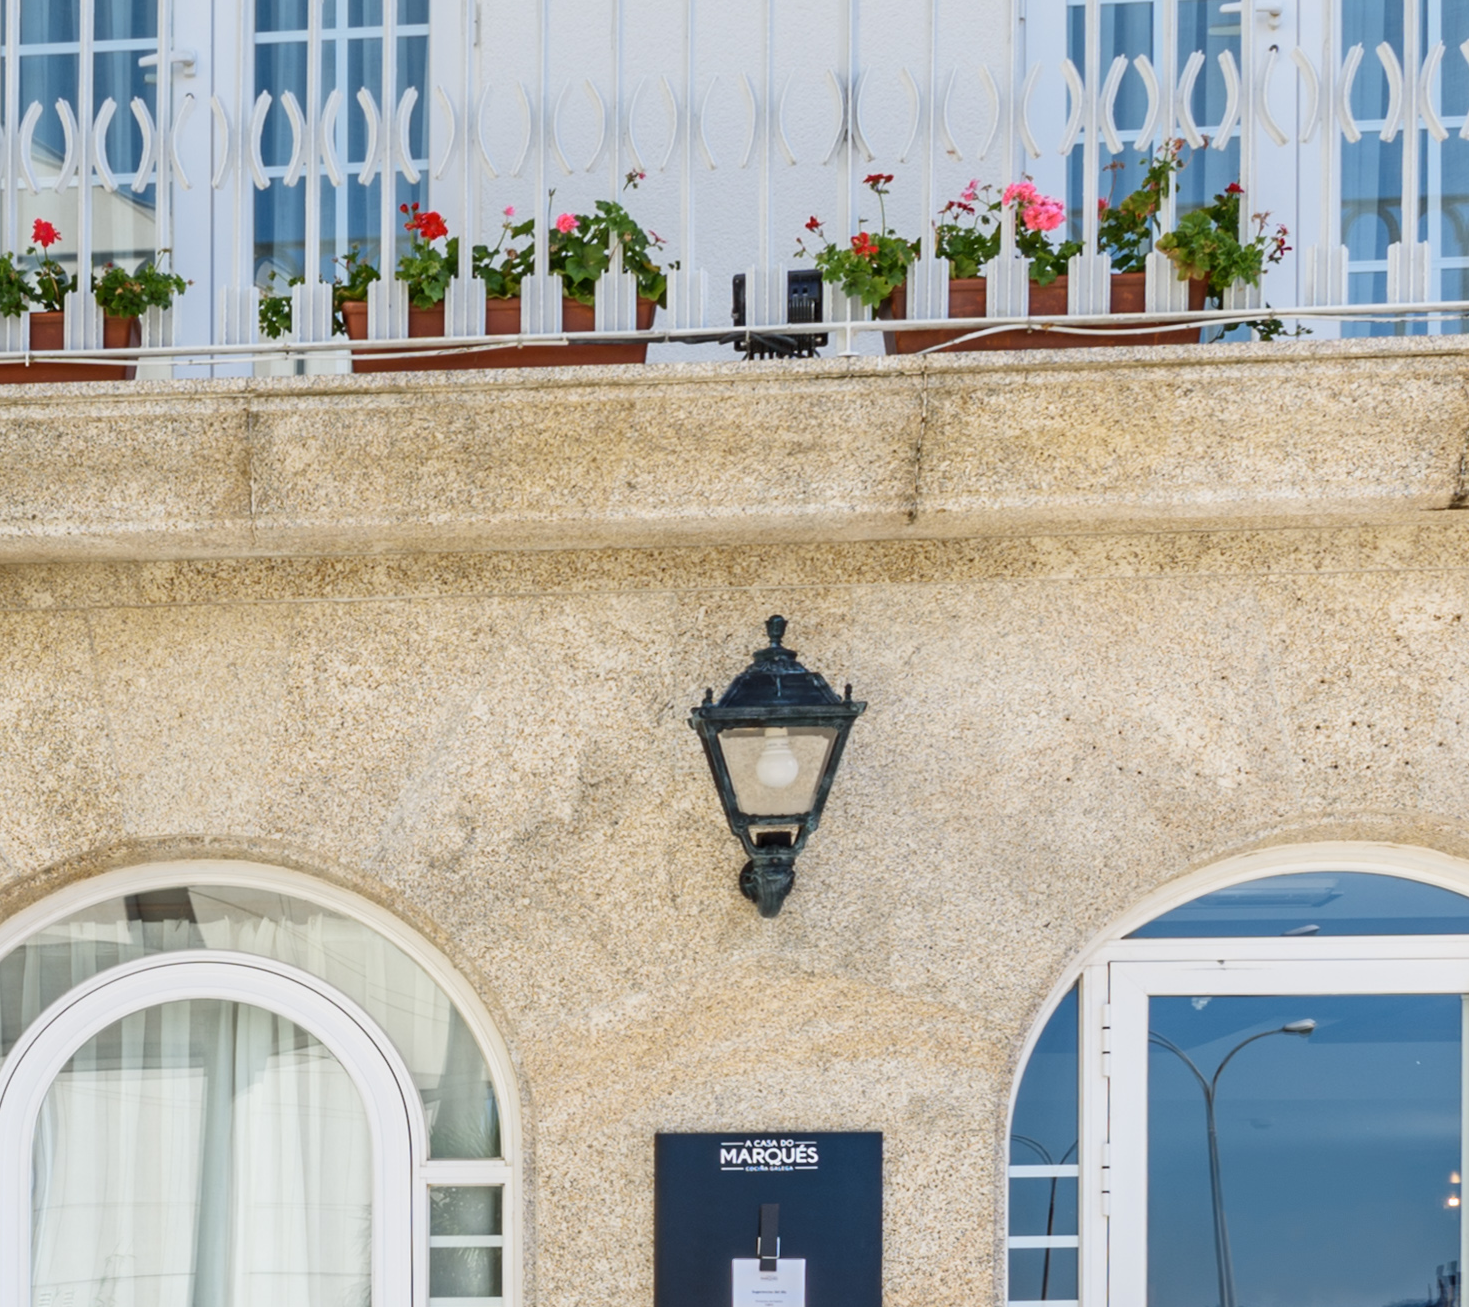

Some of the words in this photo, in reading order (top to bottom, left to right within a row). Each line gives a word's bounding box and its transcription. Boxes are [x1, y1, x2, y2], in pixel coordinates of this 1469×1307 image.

[745, 1139, 753, 1147] A
[753, 1139, 778, 1147] CASA
[780, 1139, 794, 1147] DO
[720, 1144, 819, 1166] MARQUÉS
